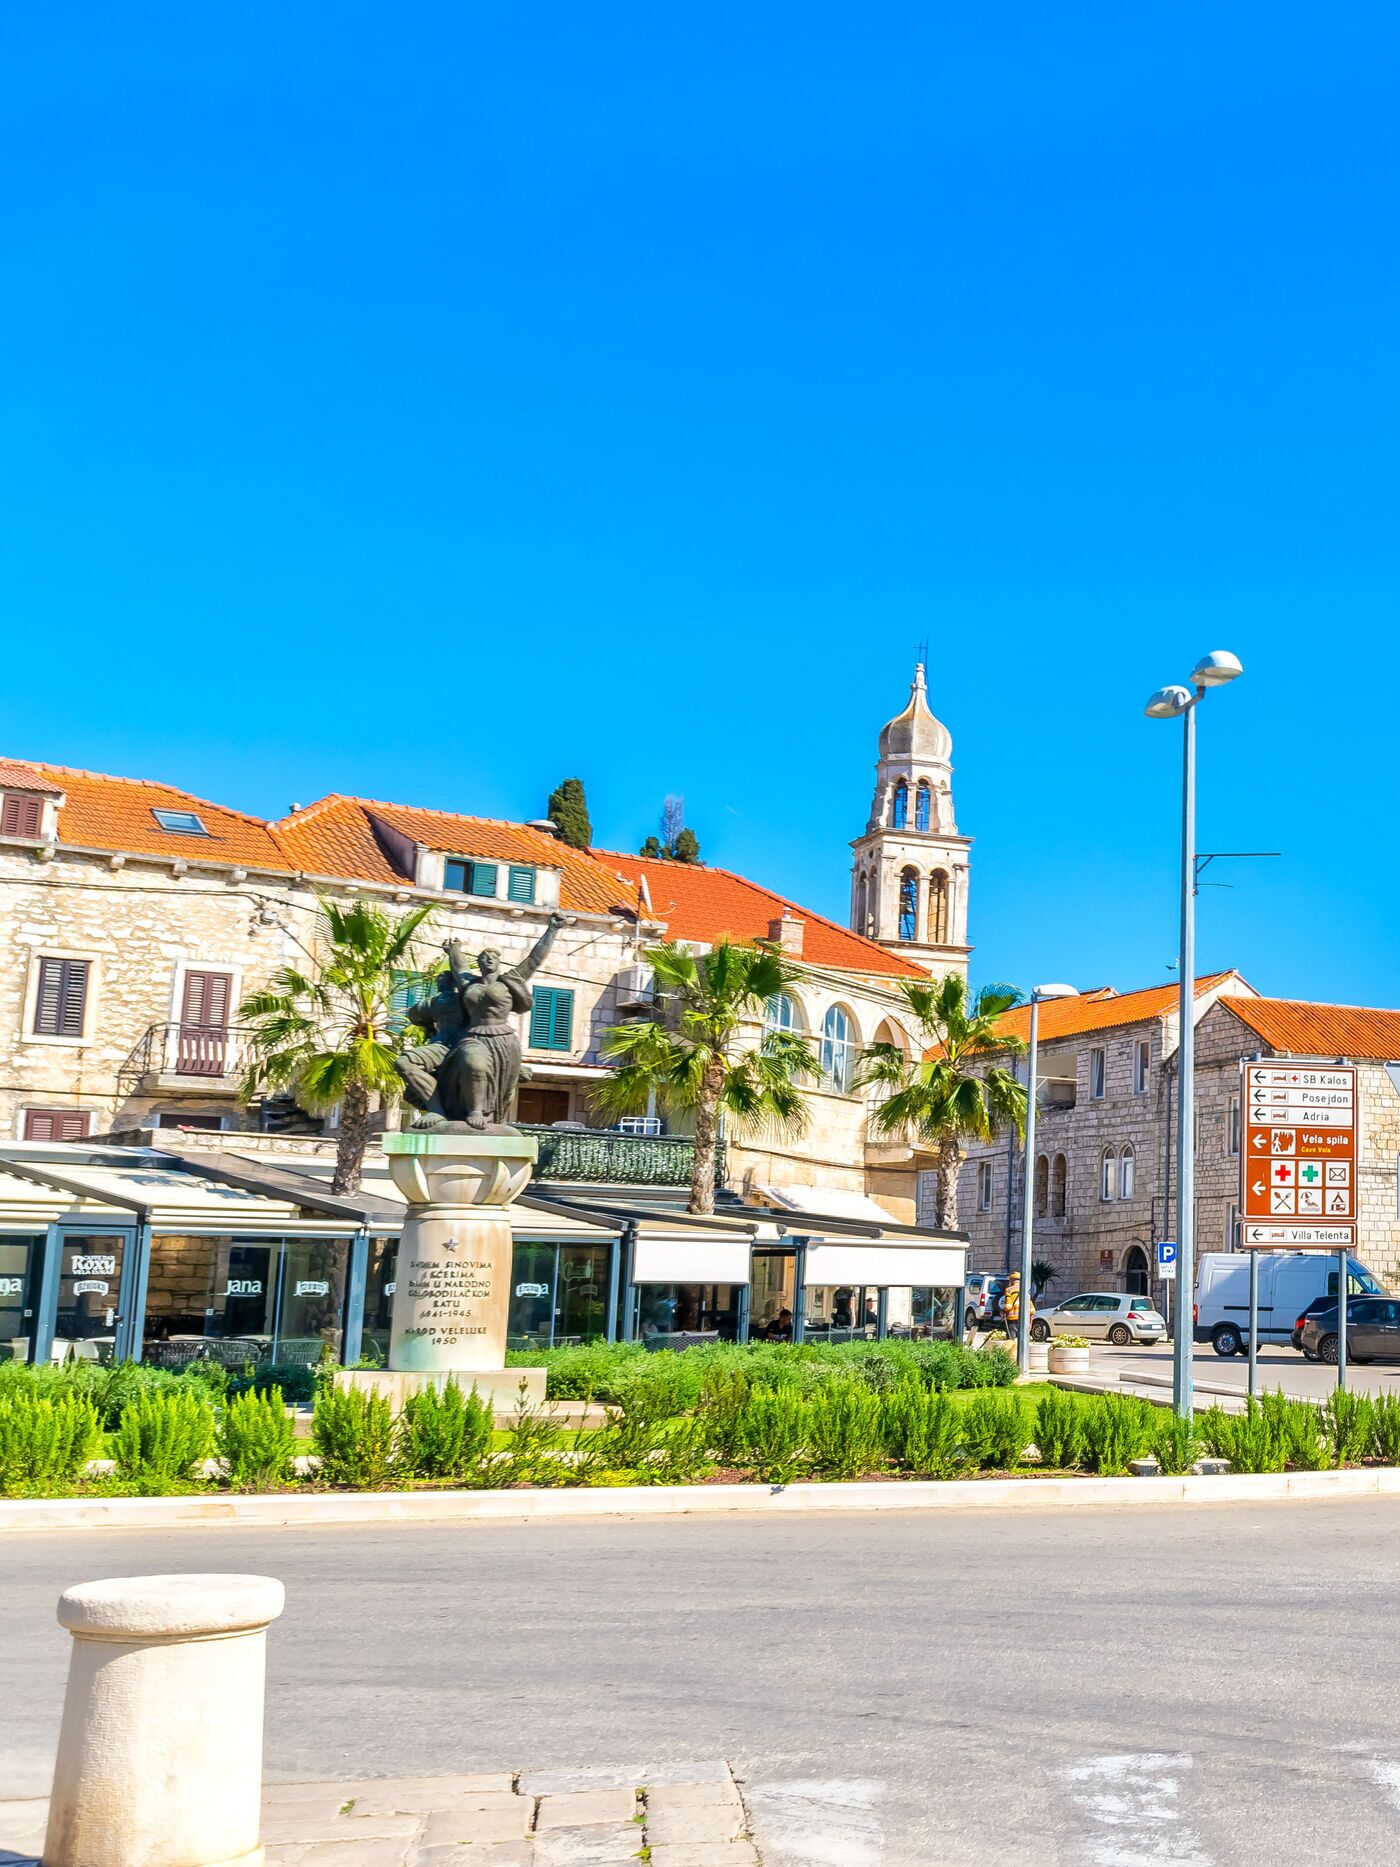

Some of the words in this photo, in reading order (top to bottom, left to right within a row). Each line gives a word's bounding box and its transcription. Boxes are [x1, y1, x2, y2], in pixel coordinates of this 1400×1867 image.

[1303, 1074, 1316, 1084] SB
[1320, 1075, 1347, 1086] Kalos
[1302, 1093, 1349, 1105] Posejdon
[1303, 1111, 1330, 1121] Adria
[1302, 1134, 1323, 1144] Vela
[1326, 1135, 1349, 1146] spila
[1291, 1230, 1312, 1240] Villa
[1314, 1230, 1349, 1240] Telenta
[1163, 1246, 1174, 1261] P
[225, 1280, 262, 1296] jana
[431, 1337, 457, 1345] 1950
